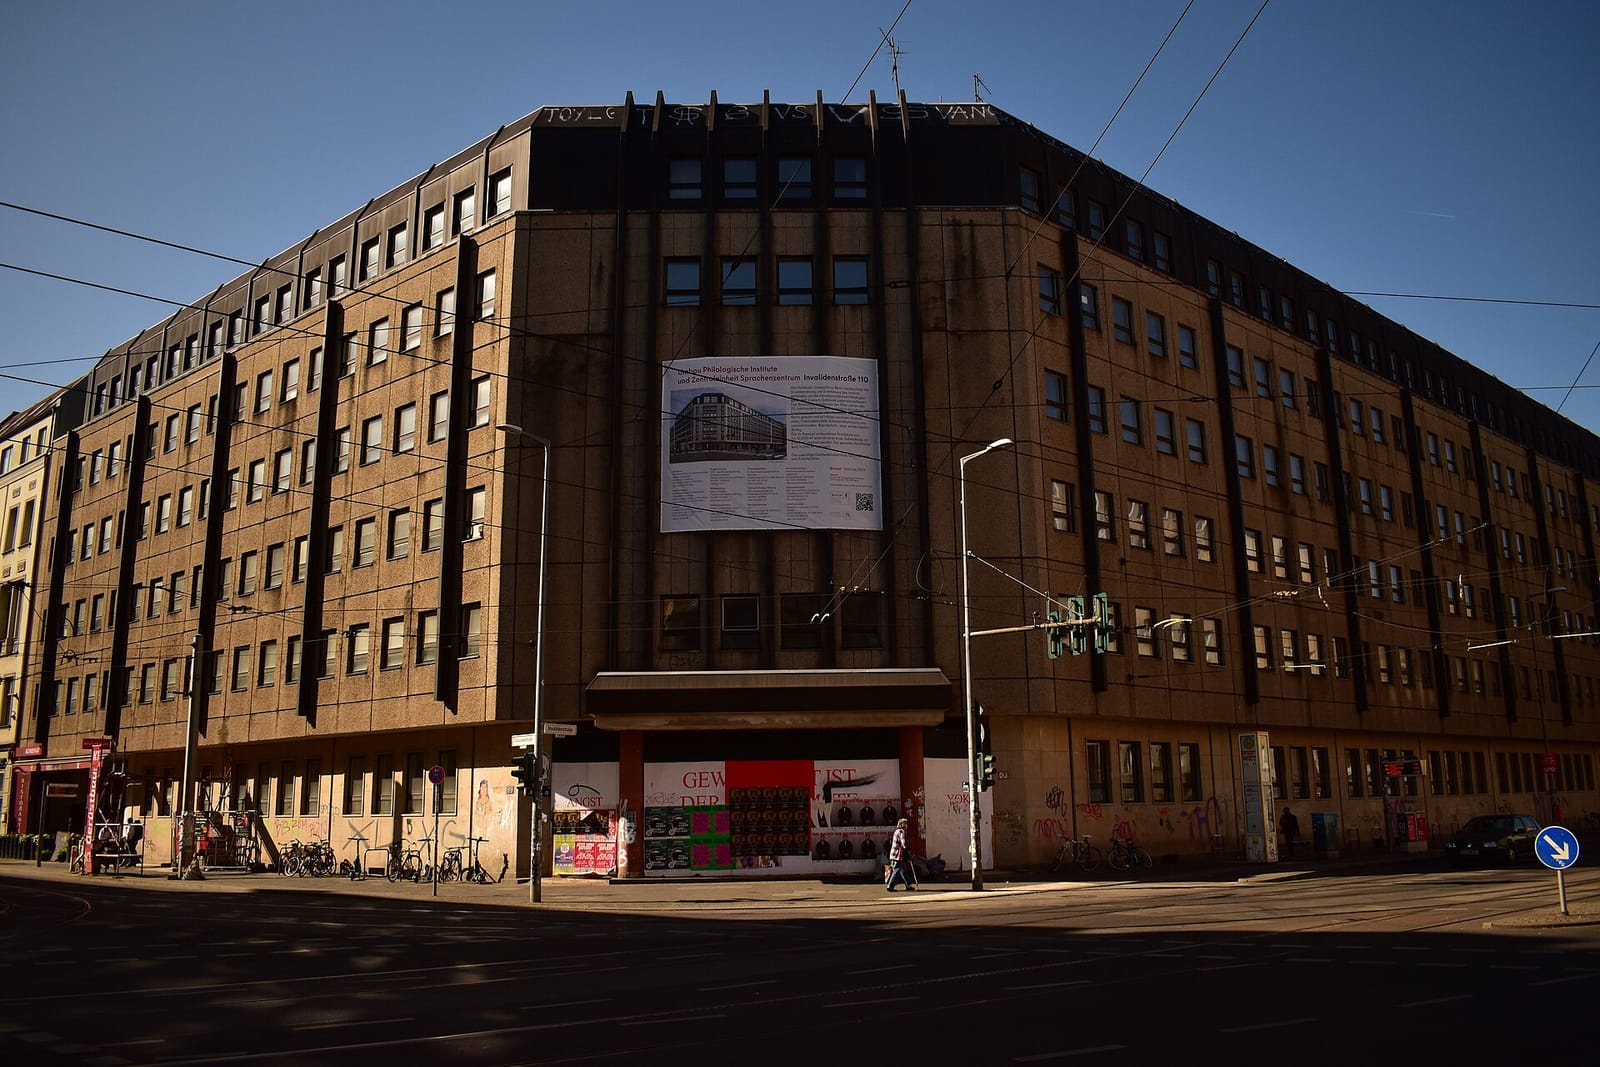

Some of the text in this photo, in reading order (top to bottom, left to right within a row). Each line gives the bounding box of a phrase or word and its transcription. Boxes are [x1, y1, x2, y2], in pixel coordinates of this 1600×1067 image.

[703, 365, 749, 374] Philologische
[750, 365, 778, 373] Institute
[678, 376, 690, 385] und
[740, 374, 801, 383] Sprachenzentrum
[803, 374, 856, 383] Invalidenstraße
[857, 376, 869, 384] 110
[567, 796, 604, 808] ANGST
